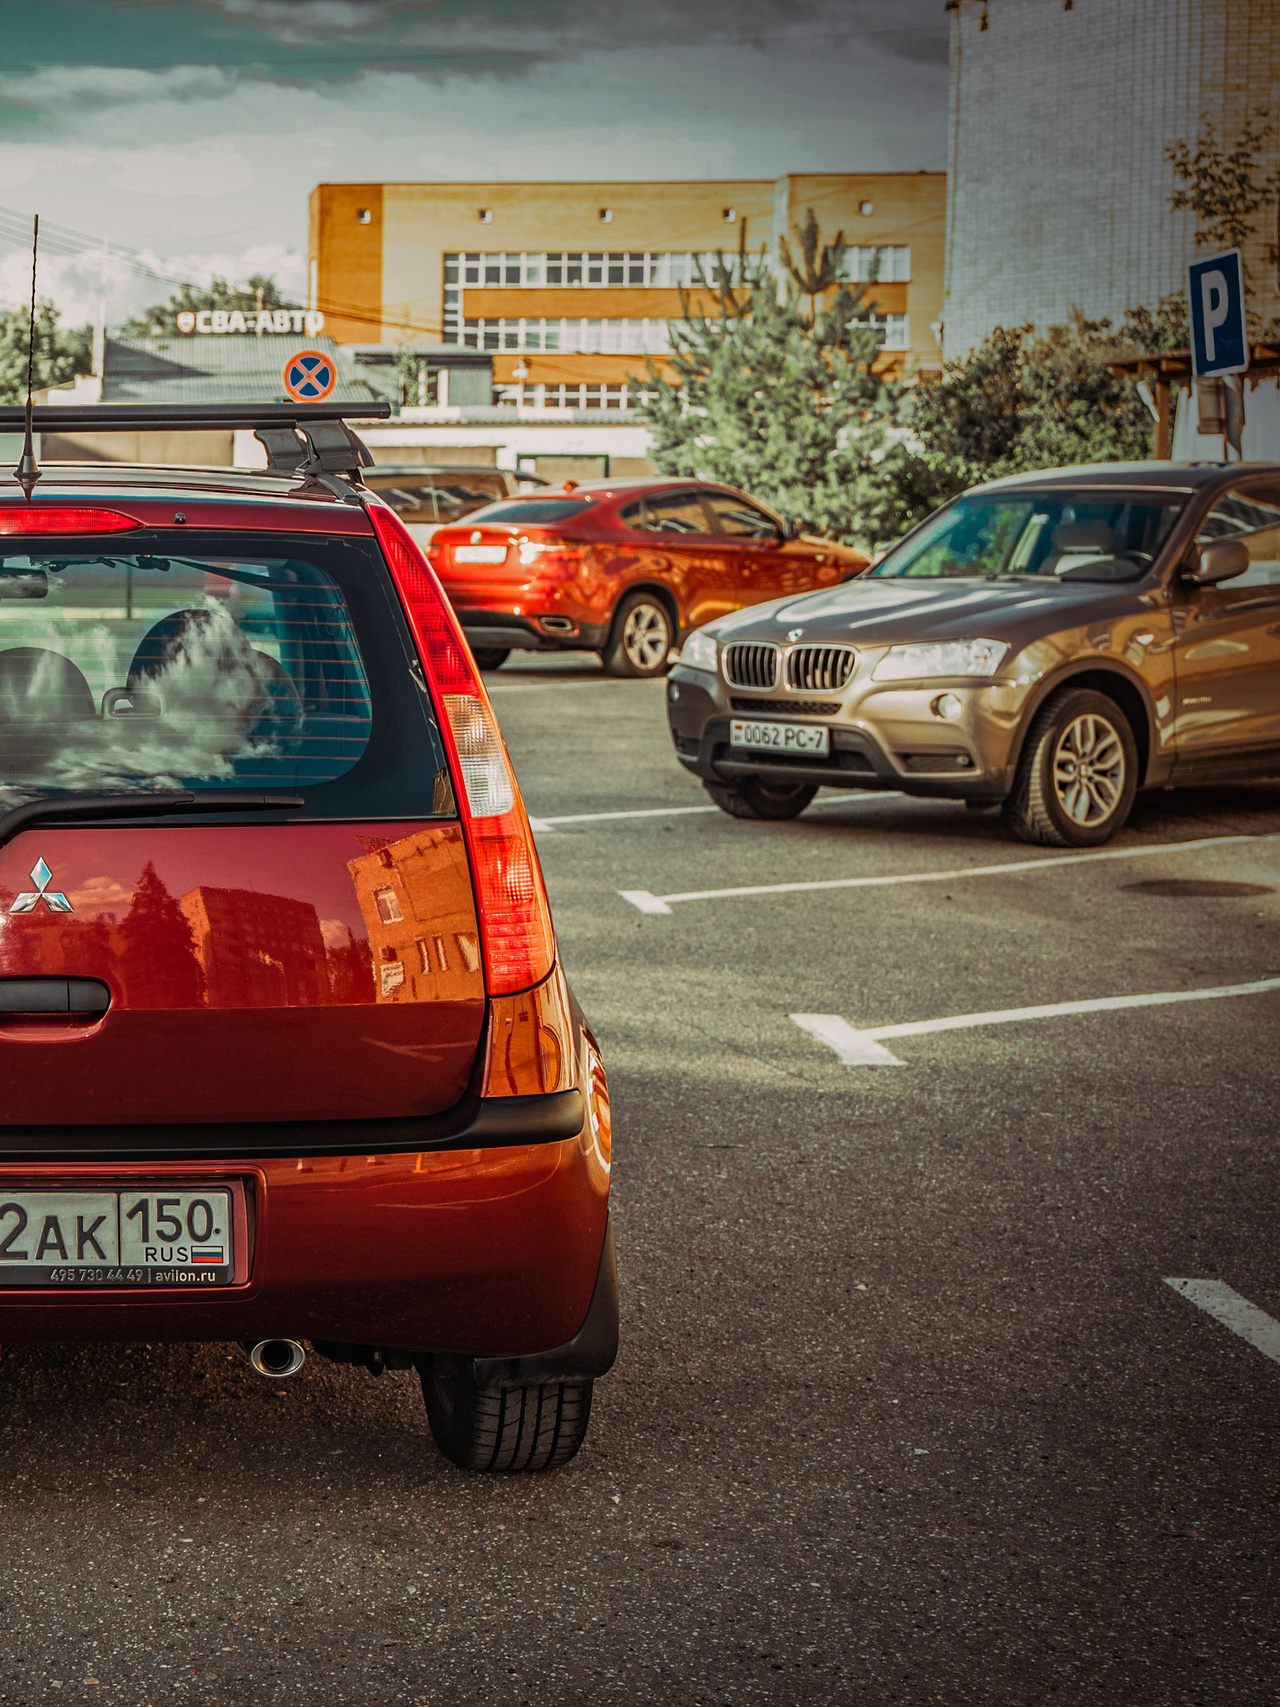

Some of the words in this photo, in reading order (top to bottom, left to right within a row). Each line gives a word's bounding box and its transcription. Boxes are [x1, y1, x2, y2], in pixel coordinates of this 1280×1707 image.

[1201, 270, 1229, 362] P
[126, 1198, 213, 1242] 150
[145, 1246, 188, 1262] RUS
[50, 1268, 75, 1282] 495
[79, 1268, 103, 1282] 730
[107, 1268, 124, 1282] 44
[127, 1268, 144, 1282] 49
[155, 1268, 217, 1282] avilon.ru
